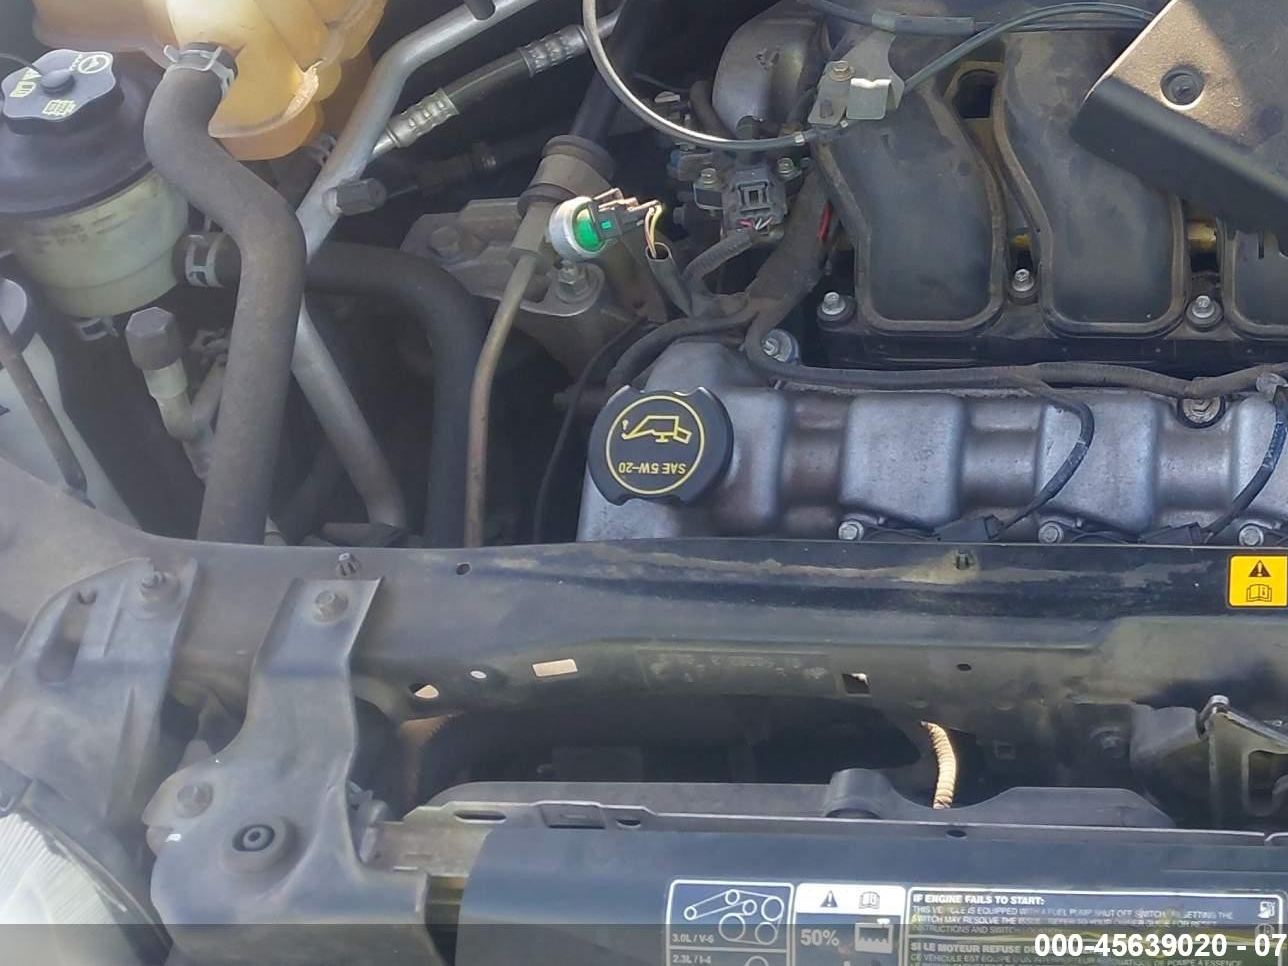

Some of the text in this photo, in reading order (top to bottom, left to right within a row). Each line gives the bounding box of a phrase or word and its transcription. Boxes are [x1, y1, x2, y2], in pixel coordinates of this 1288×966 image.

[618, 462, 687, 475] SAE 5W-20
[912, 894, 1046, 906] IF ENGINE FAILS TO START:
[912, 905, 931, 914] THIS
[967, 907, 976, 915] IS
[977, 907, 1018, 916] EQUIPPED
[1116, 909, 1133, 918] OFF
[1218, 911, 1234, 921] THE
[944, 915, 961, 923] MAY
[962, 916, 1001, 925] RESOLVE
[1001, 916, 1017, 925] THE
[911, 925, 970, 934] INSTRUCTIONS
[970, 926, 988, 934] AND
[671, 933, 692, 943] 3.0L
[699, 934, 715, 944] V-6
[799, 928, 840, 947] 50%
[910, 942, 921, 951] SI
[923, 942, 936, 952] LE
[937, 944, 981, 953] MOTEUR
[981, 945, 1022, 954] REFUSE
[671, 954, 692, 964] 2.3L
